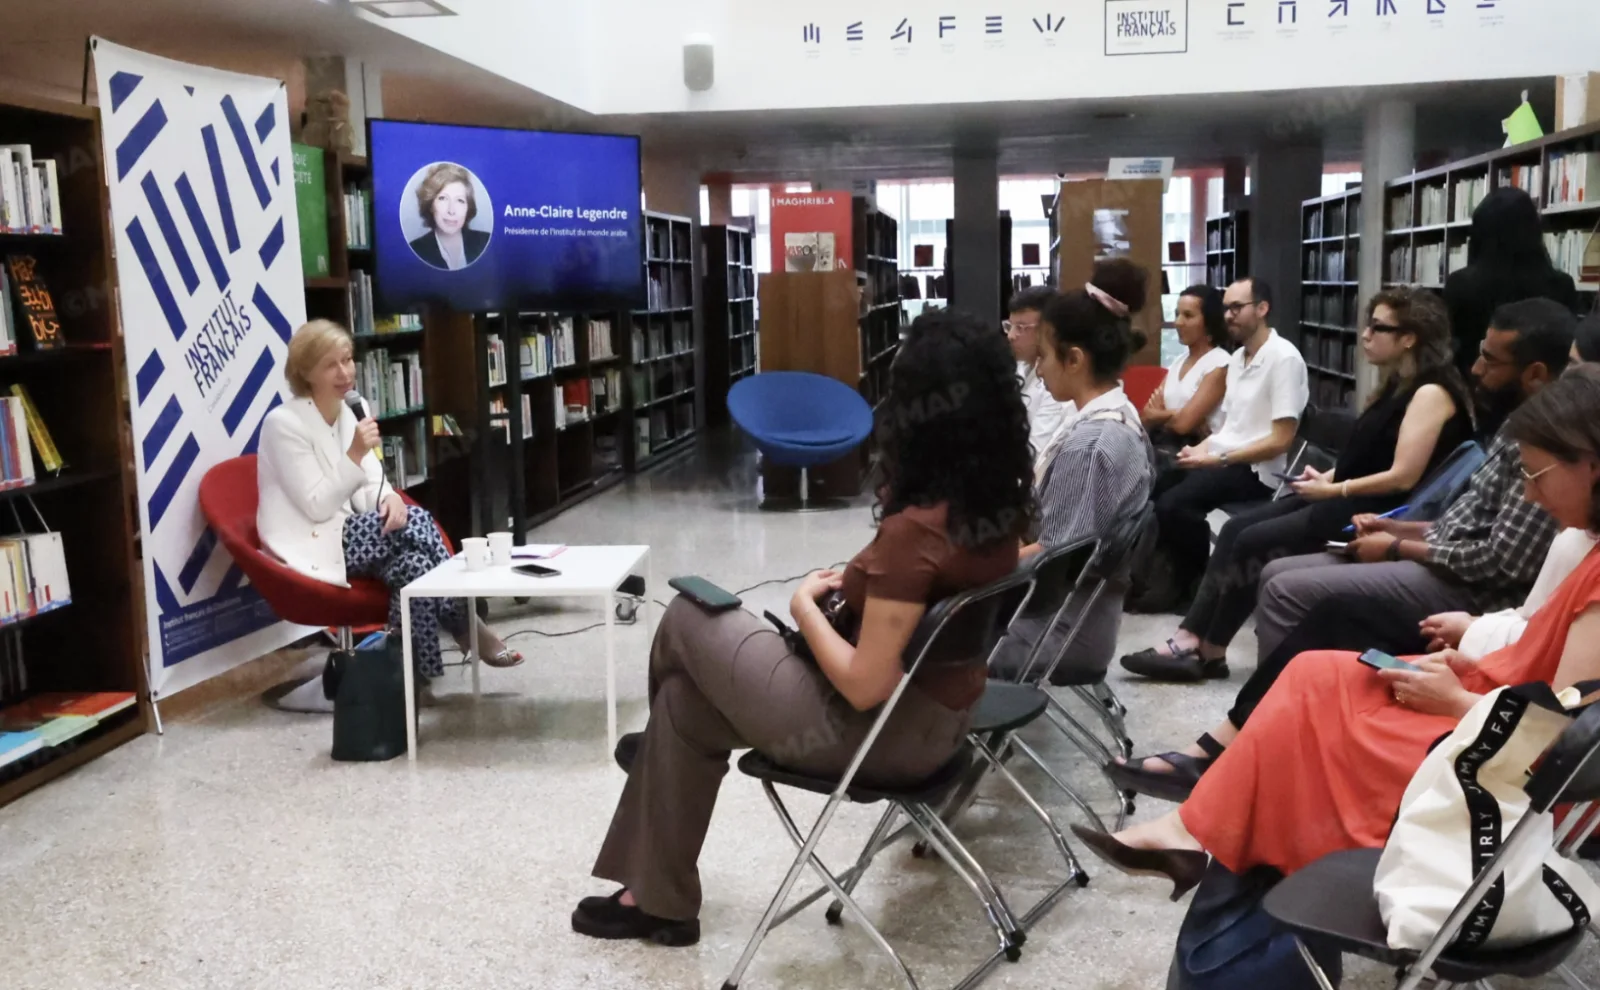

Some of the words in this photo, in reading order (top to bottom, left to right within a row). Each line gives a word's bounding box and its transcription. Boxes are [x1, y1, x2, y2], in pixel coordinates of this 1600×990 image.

[1117, 10, 1170, 26] INSTITUT
[1117, 21, 1177, 39] FRANÇAIS
[504, 204, 573, 218] Anne-Claire
[577, 207, 628, 222] Legendre
[504, 226, 539, 236] Présidente
[540, 227, 548, 236] de
[577, 228, 586, 236] du
[587, 228, 609, 237] monde
[610, 228, 628, 237] arabe
[184, 289, 237, 373] INSTITUT
[194, 304, 251, 398] FRANÇAIS
[1460, 742, 1492, 794] JIMMY
